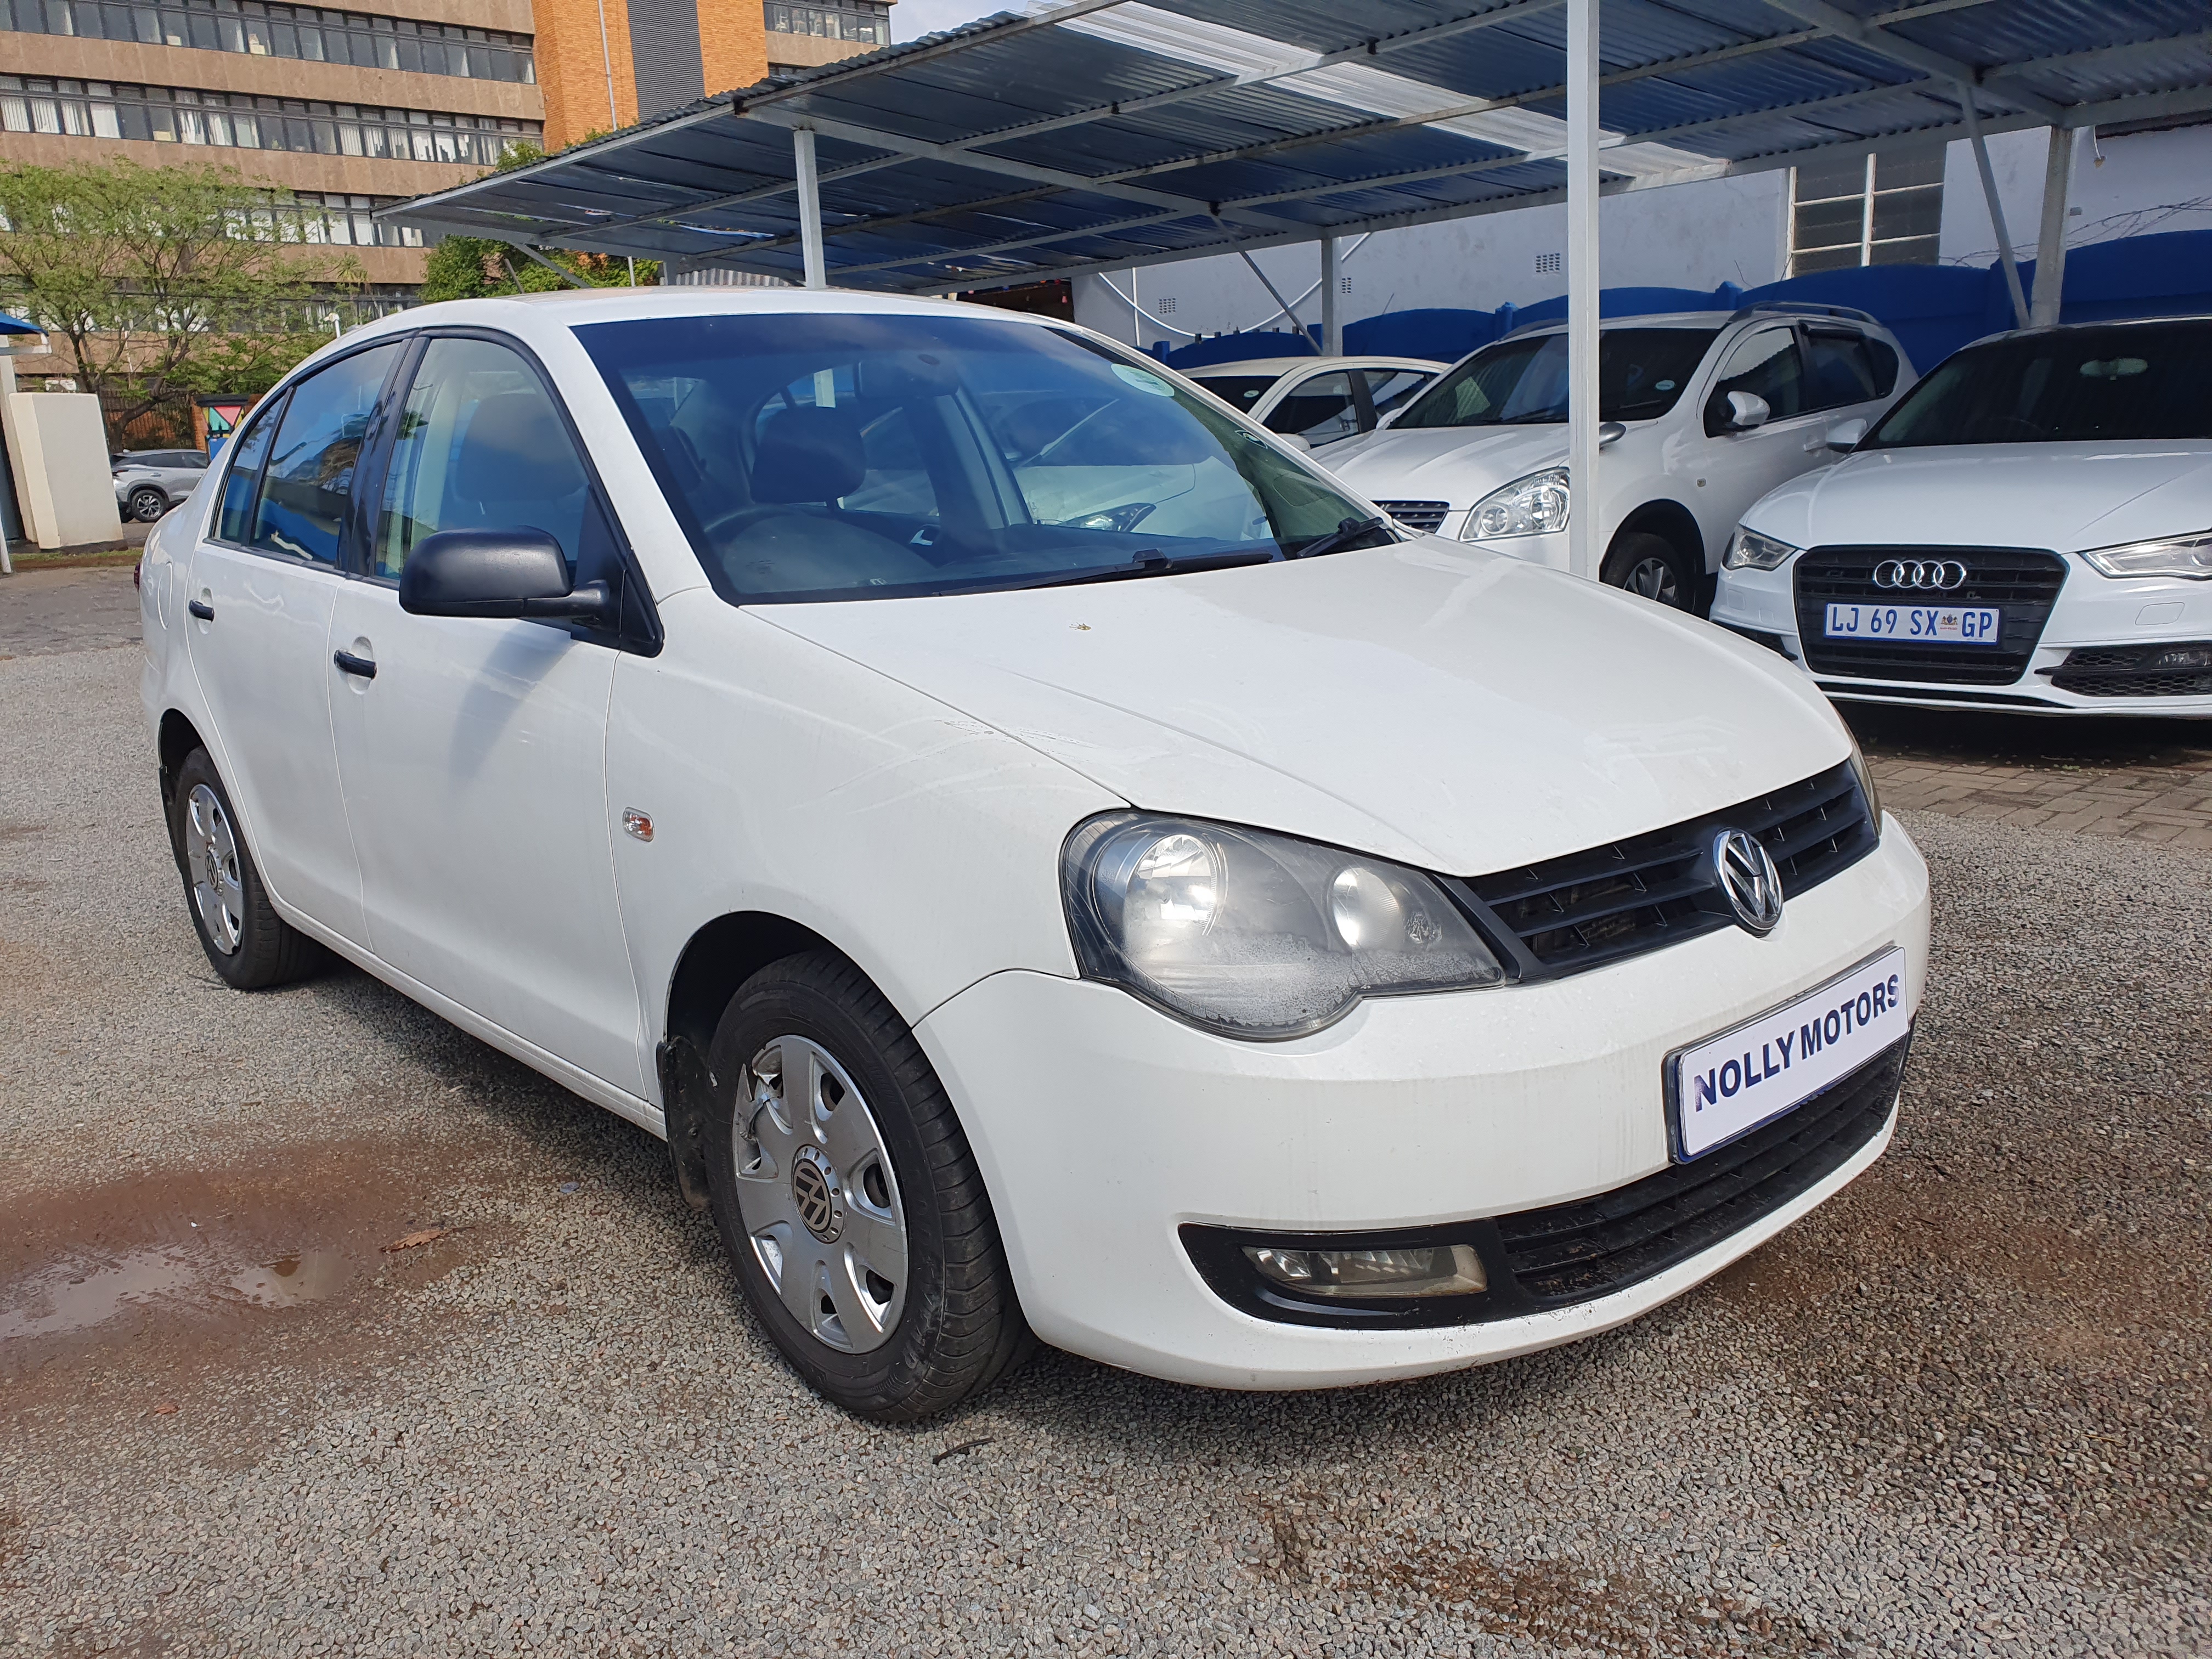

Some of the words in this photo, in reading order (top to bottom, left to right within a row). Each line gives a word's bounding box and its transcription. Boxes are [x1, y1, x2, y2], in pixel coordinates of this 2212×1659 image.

[1832, 606, 1859, 632] LJ
[1870, 608, 1898, 634] 69
[1910, 610, 1939, 636] SX
[1961, 611, 1993, 638] GP
[1694, 1030, 1796, 1112] NOLLY
[1800, 974, 1900, 1060] MOTORS
